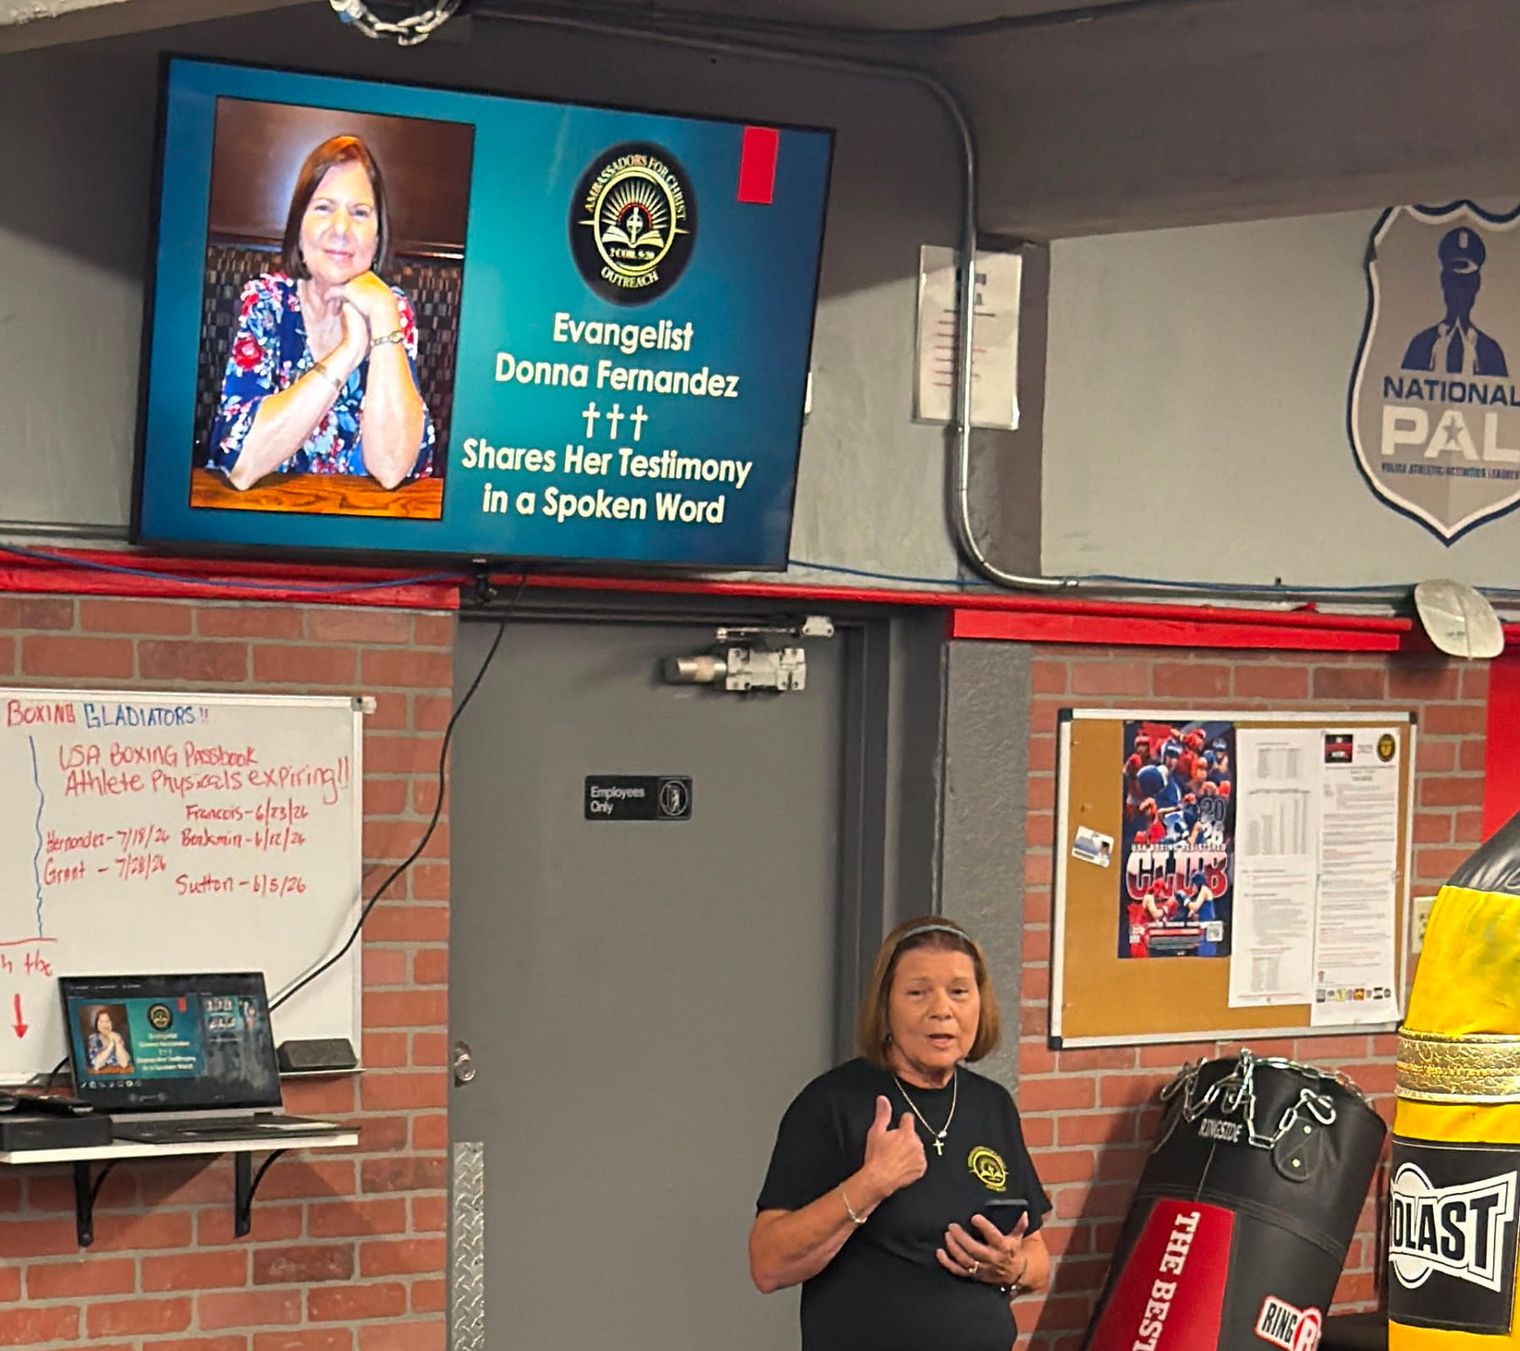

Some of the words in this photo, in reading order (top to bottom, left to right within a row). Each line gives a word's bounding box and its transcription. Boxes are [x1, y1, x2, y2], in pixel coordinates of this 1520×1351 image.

[584, 153, 648, 213] AMBASSADORS
[649, 157, 669, 178] FOR
[665, 174, 687, 221] CHRIST
[601, 266, 659, 288] OUTREACH
[553, 312, 694, 355] Evangelist
[495, 352, 588, 388] Donna
[597, 359, 740, 398] Fernandez
[1384, 377, 1520, 406] NATIONAL
[1381, 405, 1520, 463] PAL
[461, 437, 556, 474] Shares
[564, 444, 612, 475] Her
[618, 447, 752, 489] Testimony
[482, 482, 507, 514] in
[516, 491, 536, 515] a
[543, 486, 647, 523] Spoken
[656, 492, 725, 524] Word
[83, 703, 195, 728] GLADIATORS
[58, 744, 100, 771] USA
[65, 768, 144, 796] Athlete
[590, 786, 645, 800] Employees
[590, 800, 614, 815] Only
[1200, 797, 1226, 823] 20
[1126, 851, 1228, 900] CLUB
[1198, 1118, 1243, 1143] RINGSIDE
[1159, 1211, 1201, 1275] THE
[1393, 1192, 1499, 1270] OLAST
[1261, 1302, 1298, 1343] RING
